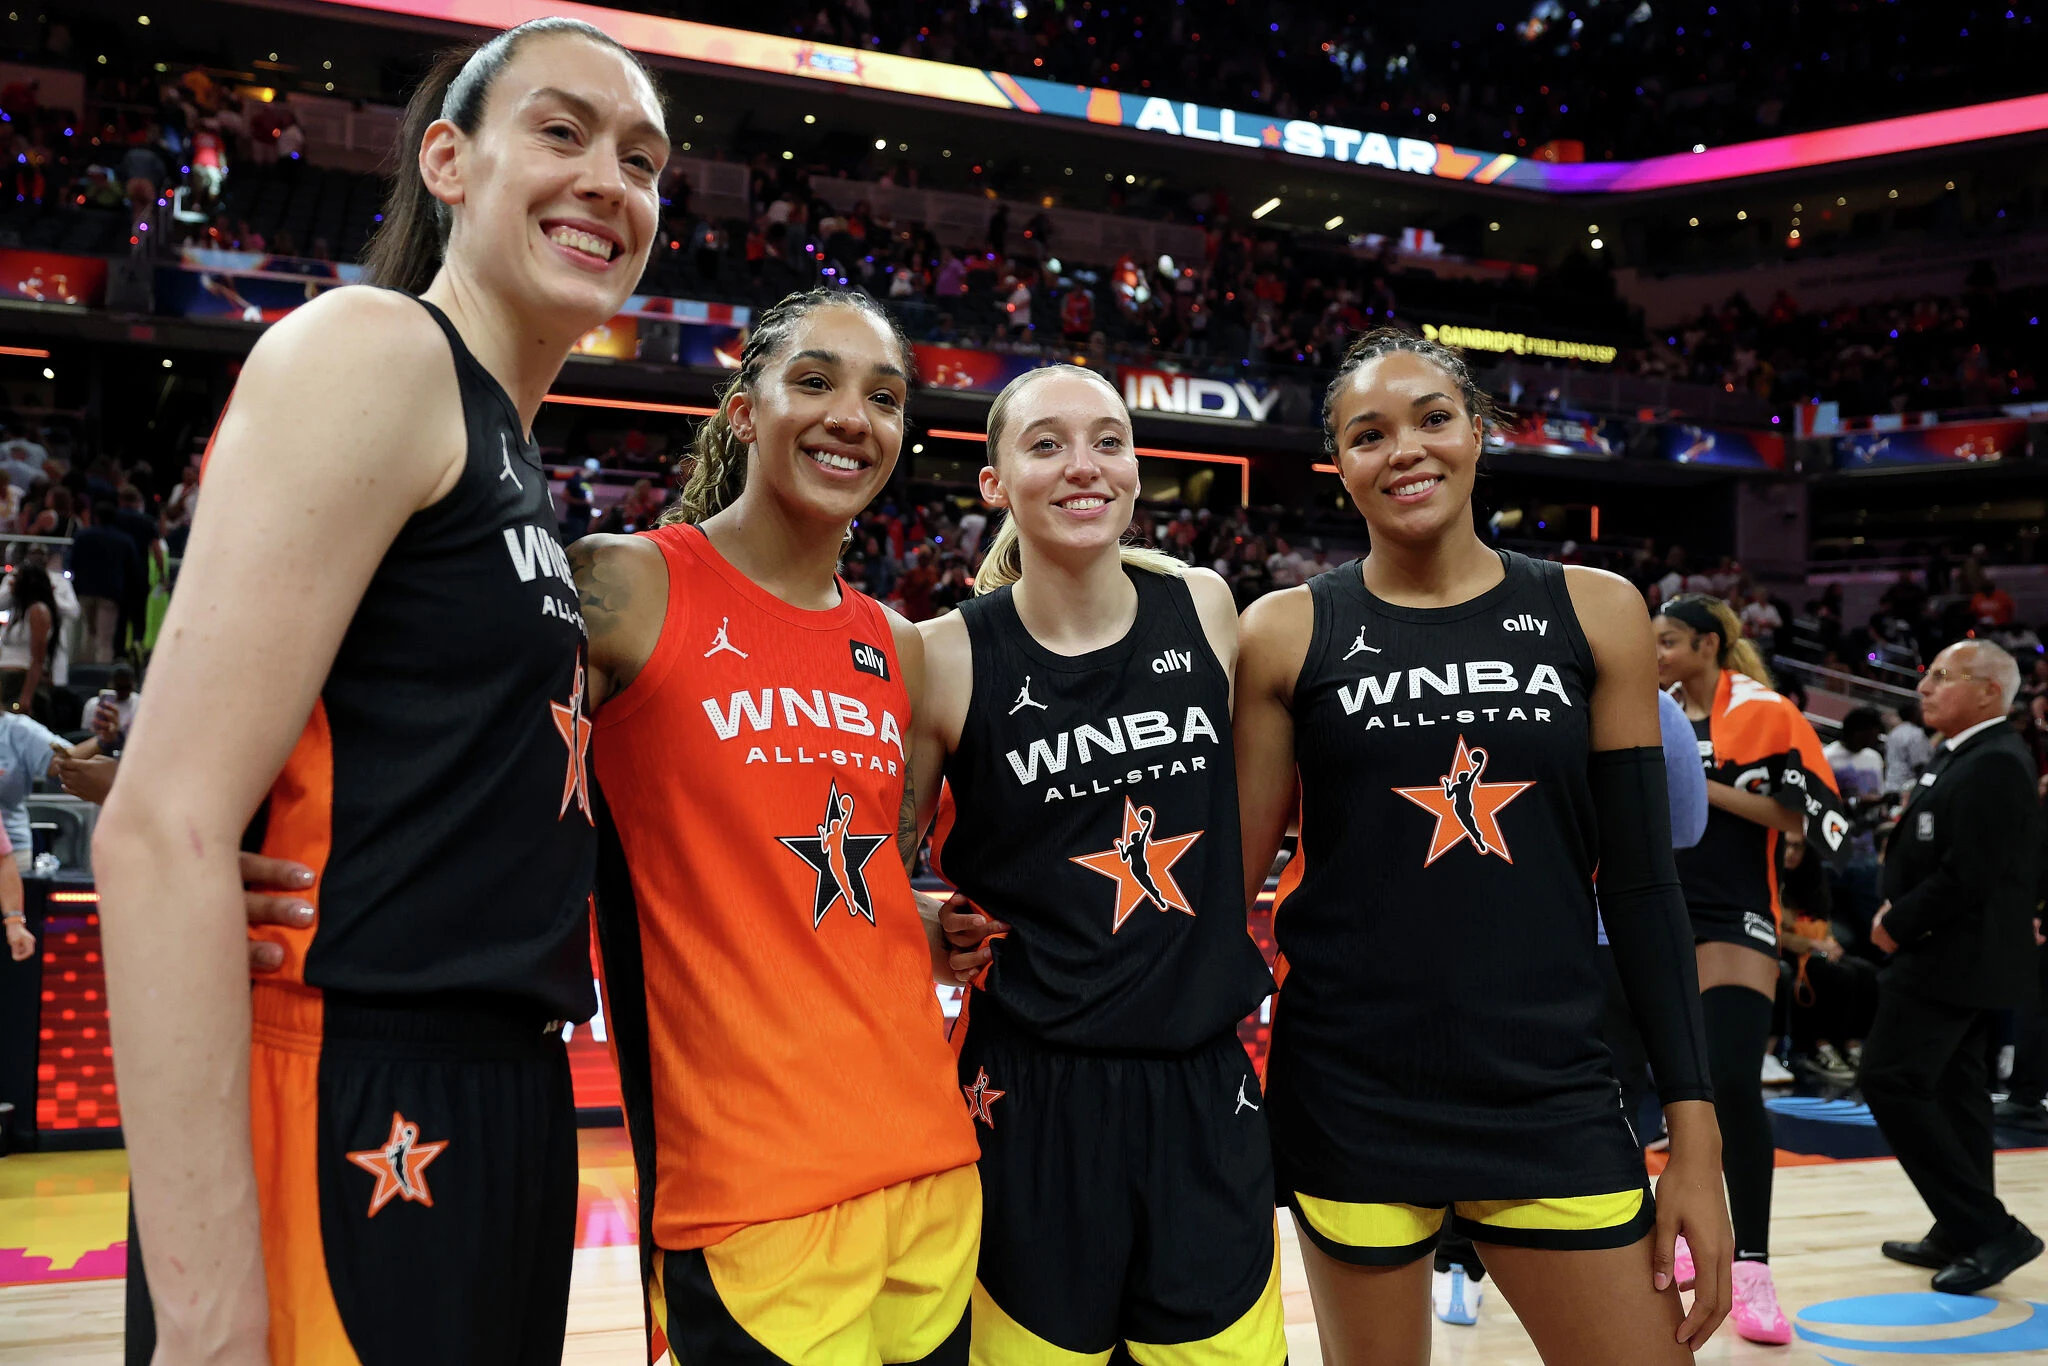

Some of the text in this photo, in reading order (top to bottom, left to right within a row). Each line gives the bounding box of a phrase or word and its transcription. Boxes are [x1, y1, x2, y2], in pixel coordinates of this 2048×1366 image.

[1135, 97, 1438, 175] ALL STAR
[1125, 374, 1281, 421] INDY
[1502, 614, 1549, 637] ally
[854, 645, 884, 677] ally
[1151, 648, 1192, 674] ally
[1337, 660, 1573, 716] WNBA
[701, 687, 905, 762] WNBA
[1365, 707, 1552, 731] ALL-STAR
[745, 746, 898, 777] ALL-STAR
[1005, 706, 1219, 786] WNBA
[1044, 756, 1207, 803] ALL-STAR
